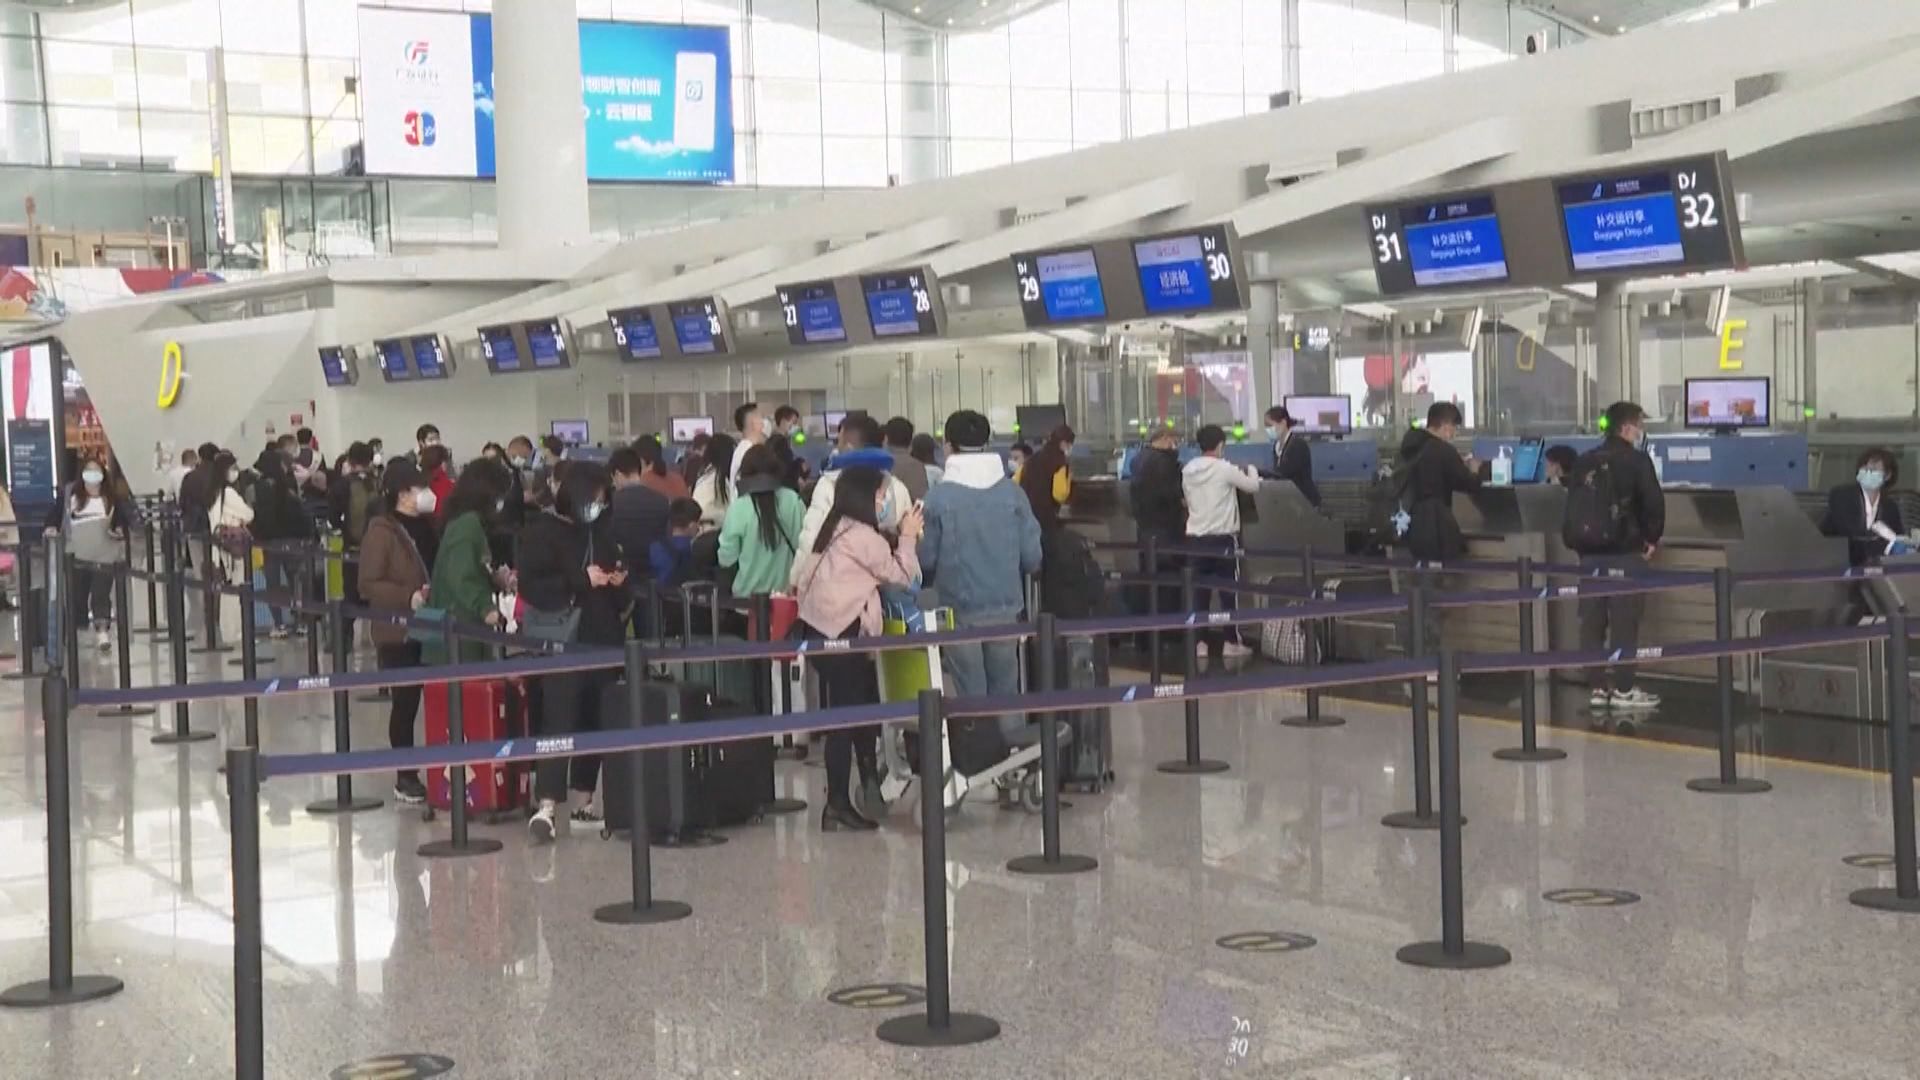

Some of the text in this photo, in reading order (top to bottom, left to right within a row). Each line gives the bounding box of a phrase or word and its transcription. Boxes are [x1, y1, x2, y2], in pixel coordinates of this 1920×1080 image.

[1680, 192, 1719, 229] 32
[1375, 231, 1402, 264] 31
[1207, 252, 1230, 282] 30
[912, 289, 931, 313] 28
[1020, 275, 1040, 302] 29
[784, 304, 798, 326] 27
[1719, 320, 1748, 370] E
[157, 340, 182, 409] D
